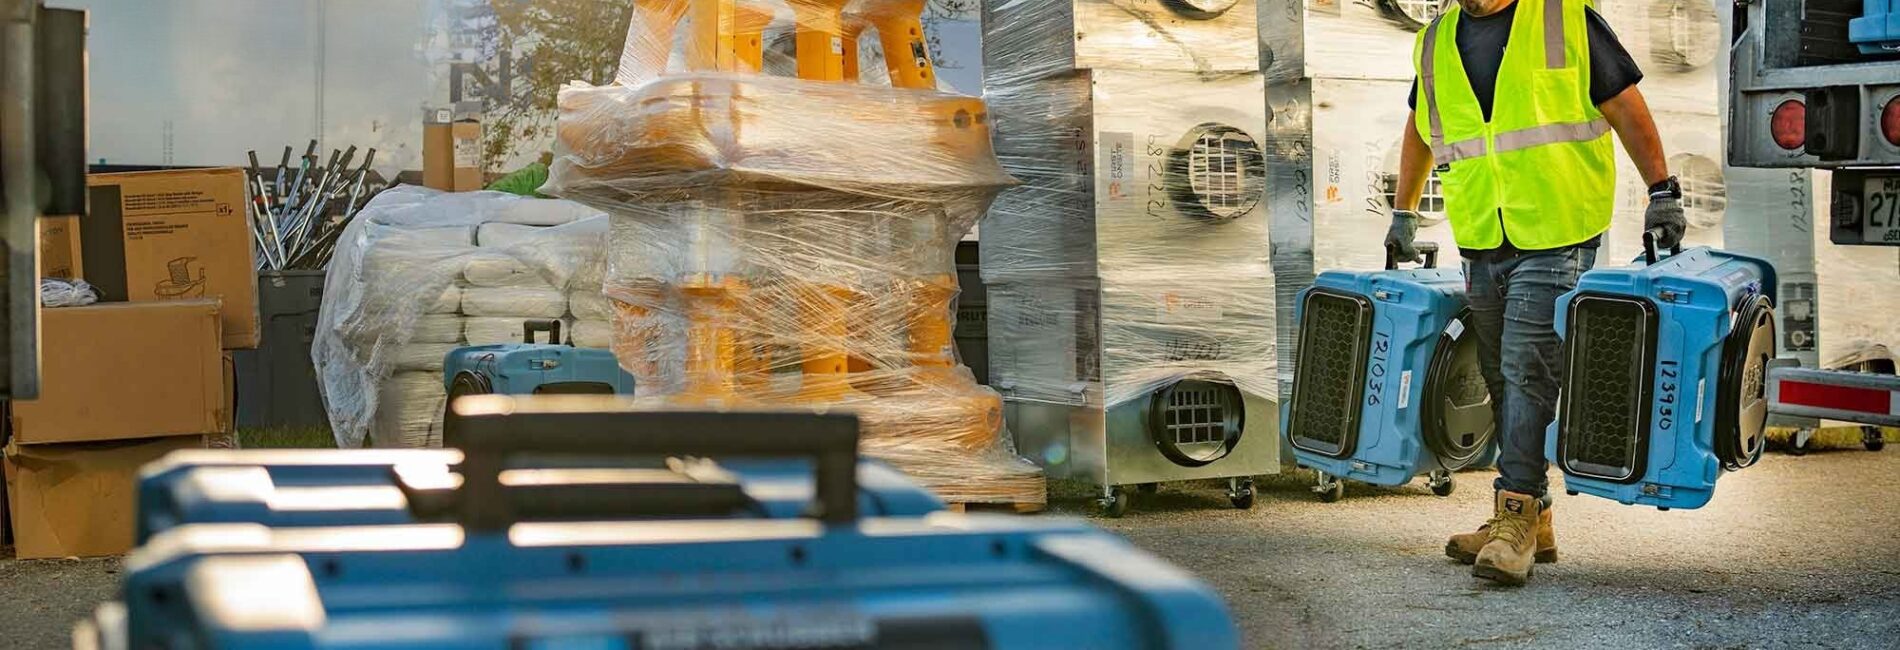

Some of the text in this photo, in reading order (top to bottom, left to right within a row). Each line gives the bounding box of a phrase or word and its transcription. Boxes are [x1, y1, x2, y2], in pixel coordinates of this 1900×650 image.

[1146, 134, 1168, 221] 122289
[1870, 192, 1900, 227] 27
[1367, 331, 1389, 406] 121036
[1659, 361, 1678, 430] 123930
